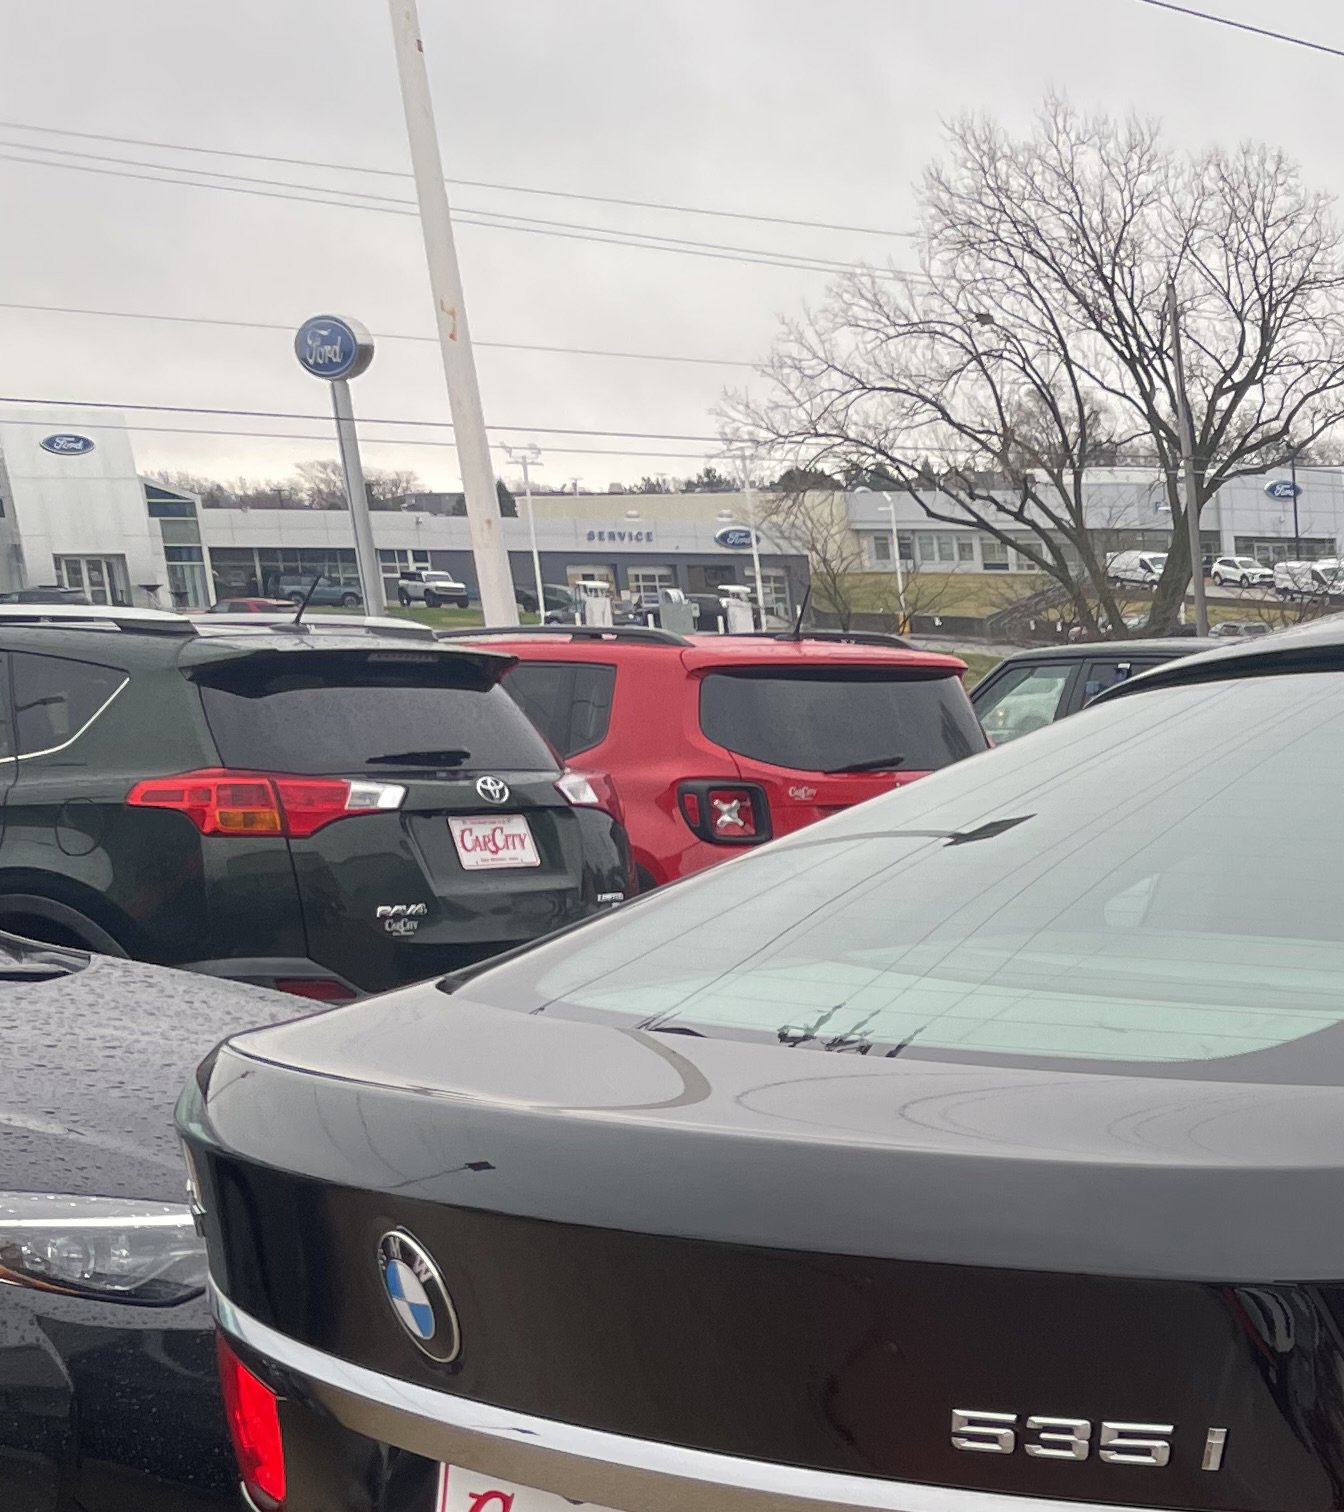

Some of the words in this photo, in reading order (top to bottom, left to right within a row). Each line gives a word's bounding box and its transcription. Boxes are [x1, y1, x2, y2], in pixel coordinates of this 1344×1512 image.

[306, 327, 344, 365] Ford
[53, 436, 85, 451] Ford
[586, 530, 654, 543] SERVICE
